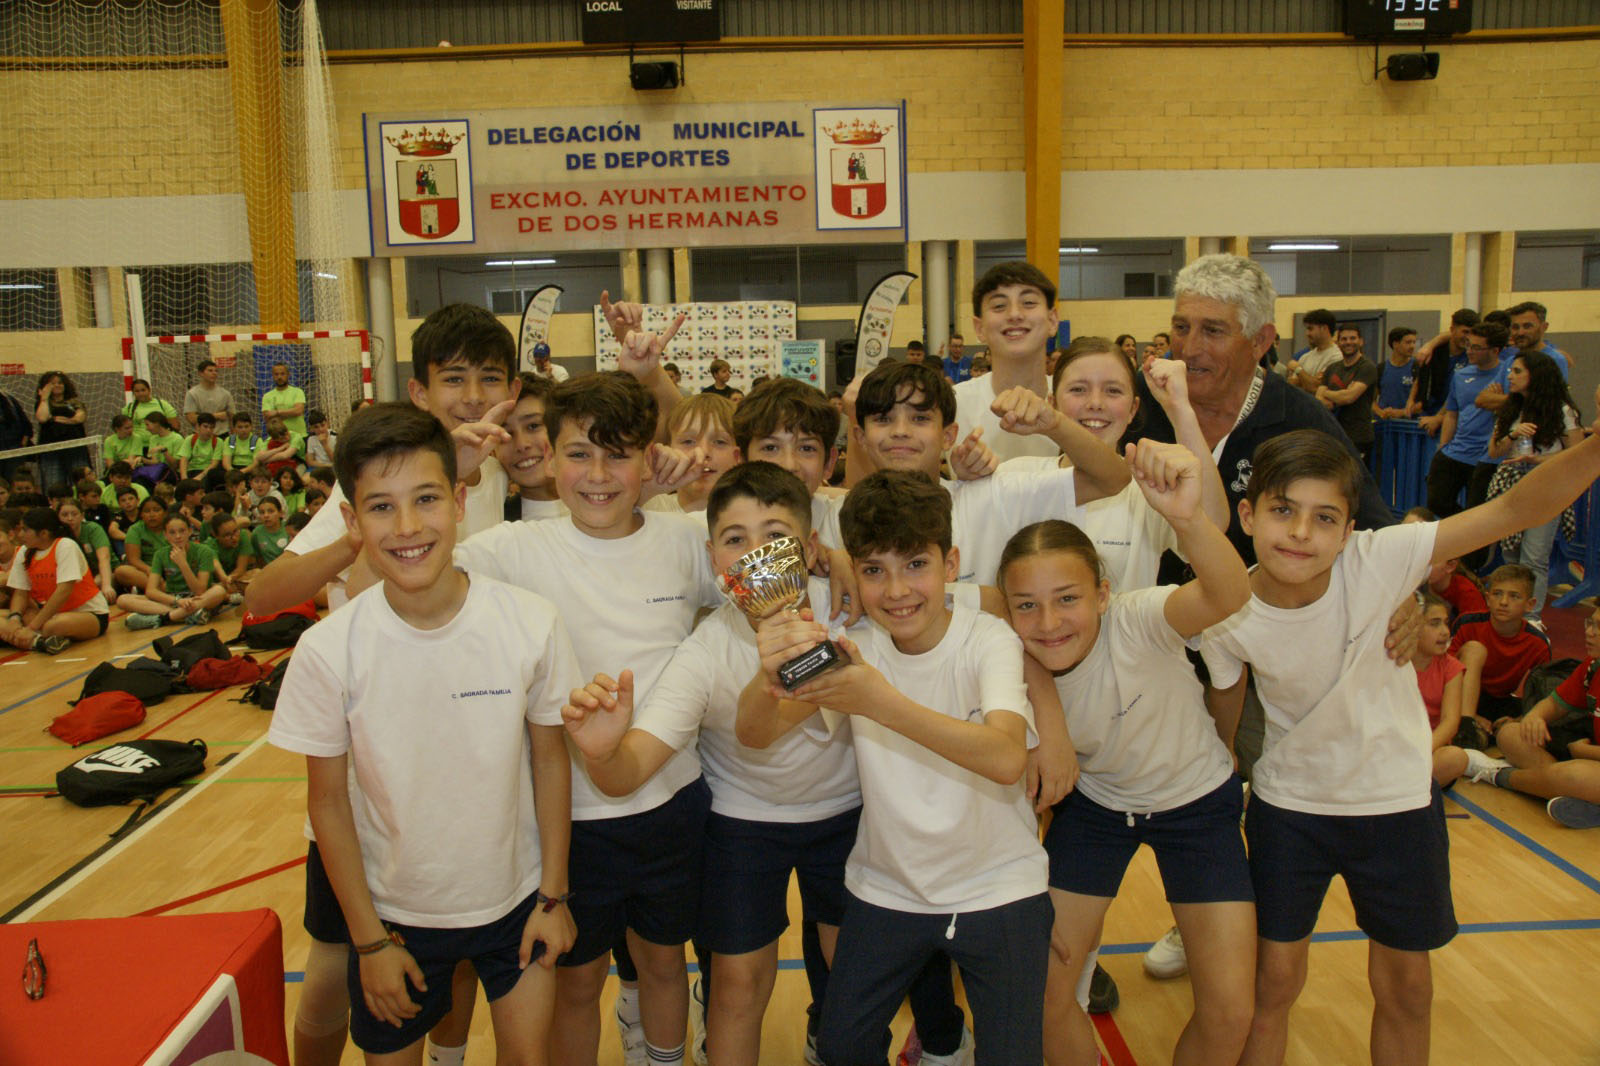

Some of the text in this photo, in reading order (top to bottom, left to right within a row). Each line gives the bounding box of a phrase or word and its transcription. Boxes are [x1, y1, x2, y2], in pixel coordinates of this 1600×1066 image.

[586, 1, 623, 12] LOCAL
[676, 0, 713, 10] VISITANTE
[487, 120, 805, 146] DELEGACIÓN MUNICIPAL
[565, 149, 730, 171] DE DEPORTES
[490, 184, 807, 210] EXCMO. AYUNTAMIENTO
[518, 209, 779, 233] DE DOS HERMANAS
[90, 745, 161, 769] NIKE
